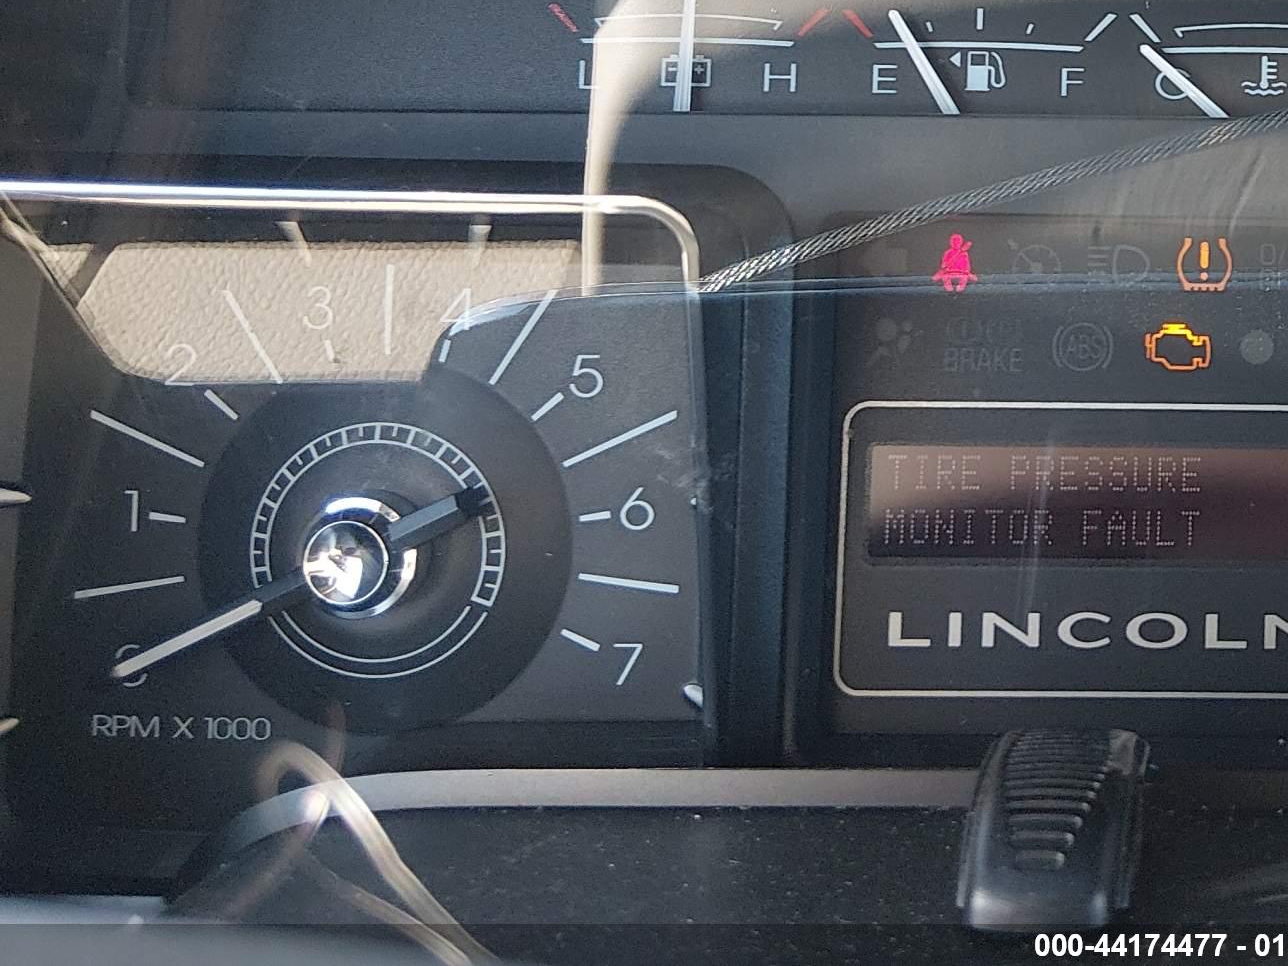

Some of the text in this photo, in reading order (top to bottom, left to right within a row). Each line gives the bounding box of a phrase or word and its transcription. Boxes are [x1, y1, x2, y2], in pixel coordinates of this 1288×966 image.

[763, 63, 797, 93] H
[872, 64, 898, 95] E
[1060, 67, 1085, 97] F
[301, 286, 334, 330] 3
[438, 287, 473, 332] 4
[163, 343, 198, 387] 2
[943, 348, 1024, 372] BRAKE
[1067, 334, 1101, 360] ABS
[568, 354, 604, 398] 5
[888, 454, 1202, 493] TIRE PRESSURE
[124, 490, 140, 532] 1
[619, 488, 656, 531] 6
[883, 507, 1202, 548] MONITOR FAULT
[613, 643, 644, 686] 7
[91, 715, 272, 741] RPM X 1000
